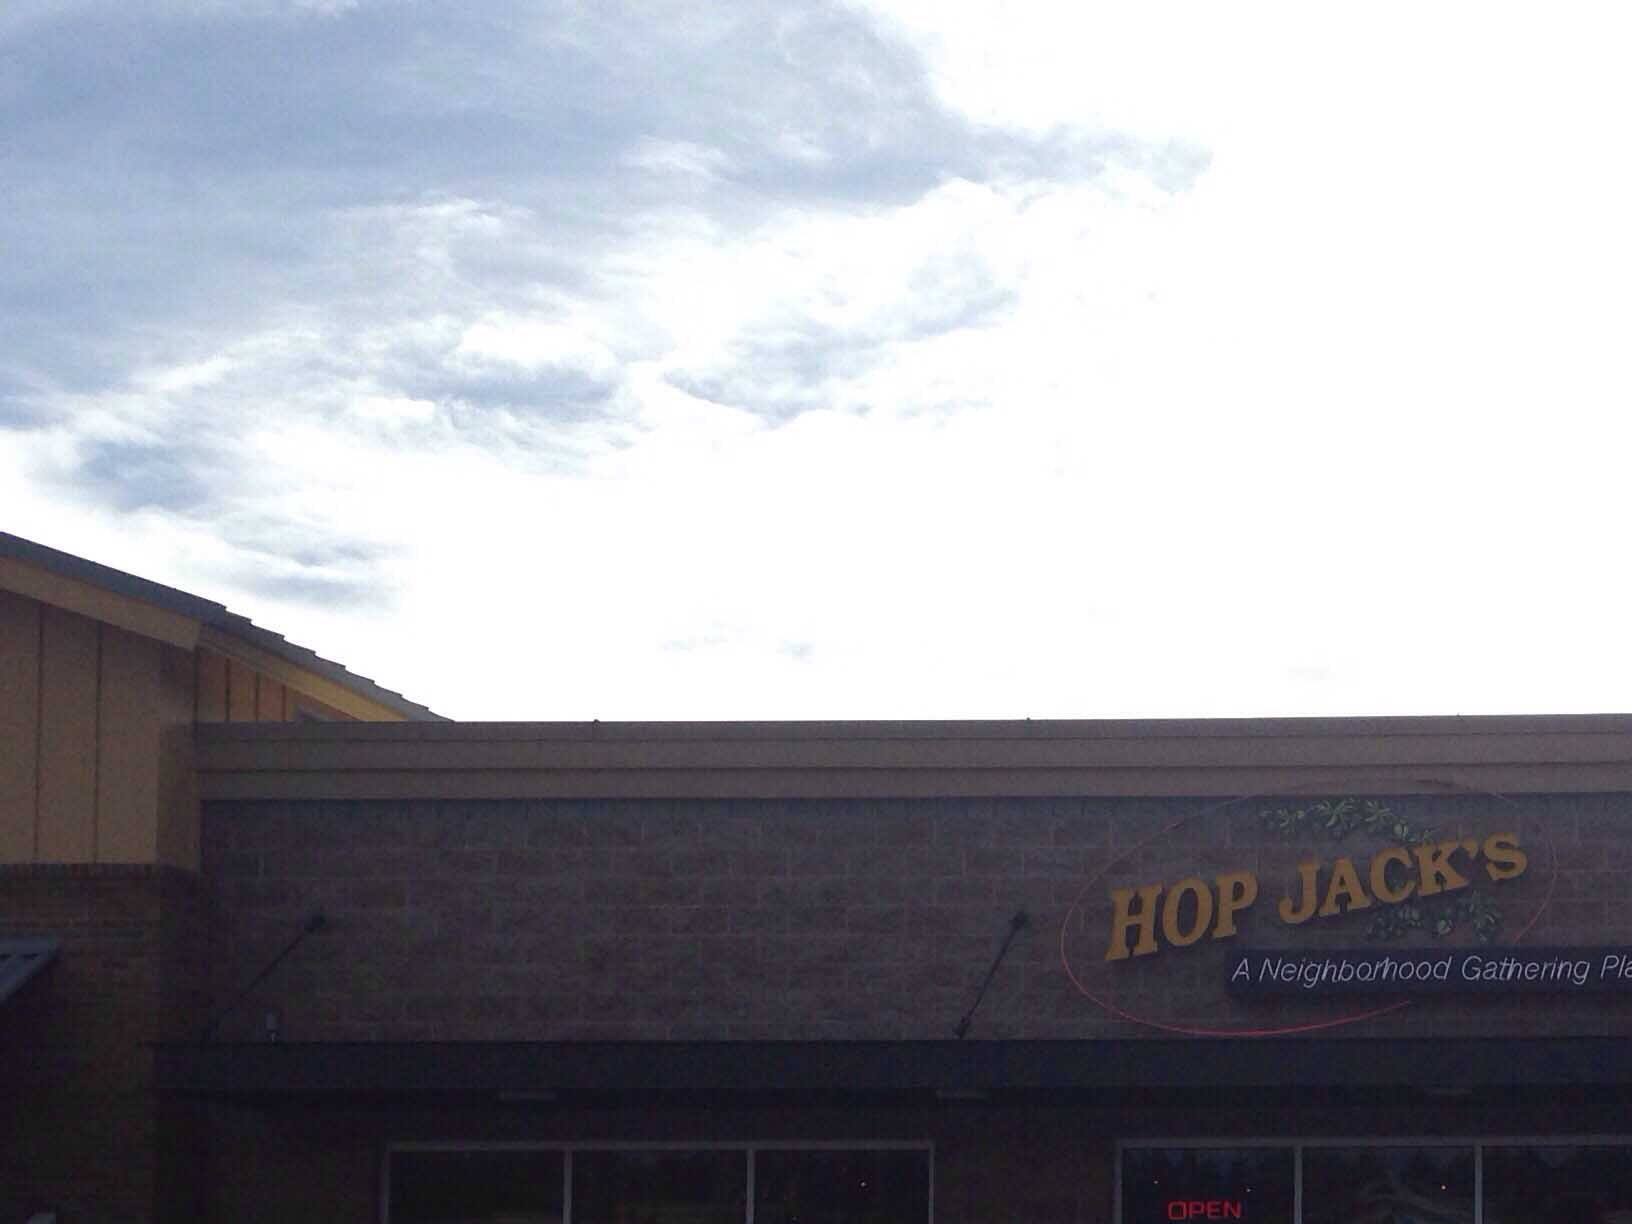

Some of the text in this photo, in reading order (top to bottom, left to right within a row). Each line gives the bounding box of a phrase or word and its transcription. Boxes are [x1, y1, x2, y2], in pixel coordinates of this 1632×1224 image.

[1104, 832, 1527, 960] HOP JACK'S
[1232, 957, 1251, 982] A
[1259, 955, 1453, 989] Neighborhood
[1462, 955, 1591, 985] Gathering
[1167, 1200, 1243, 1220] OPEN
